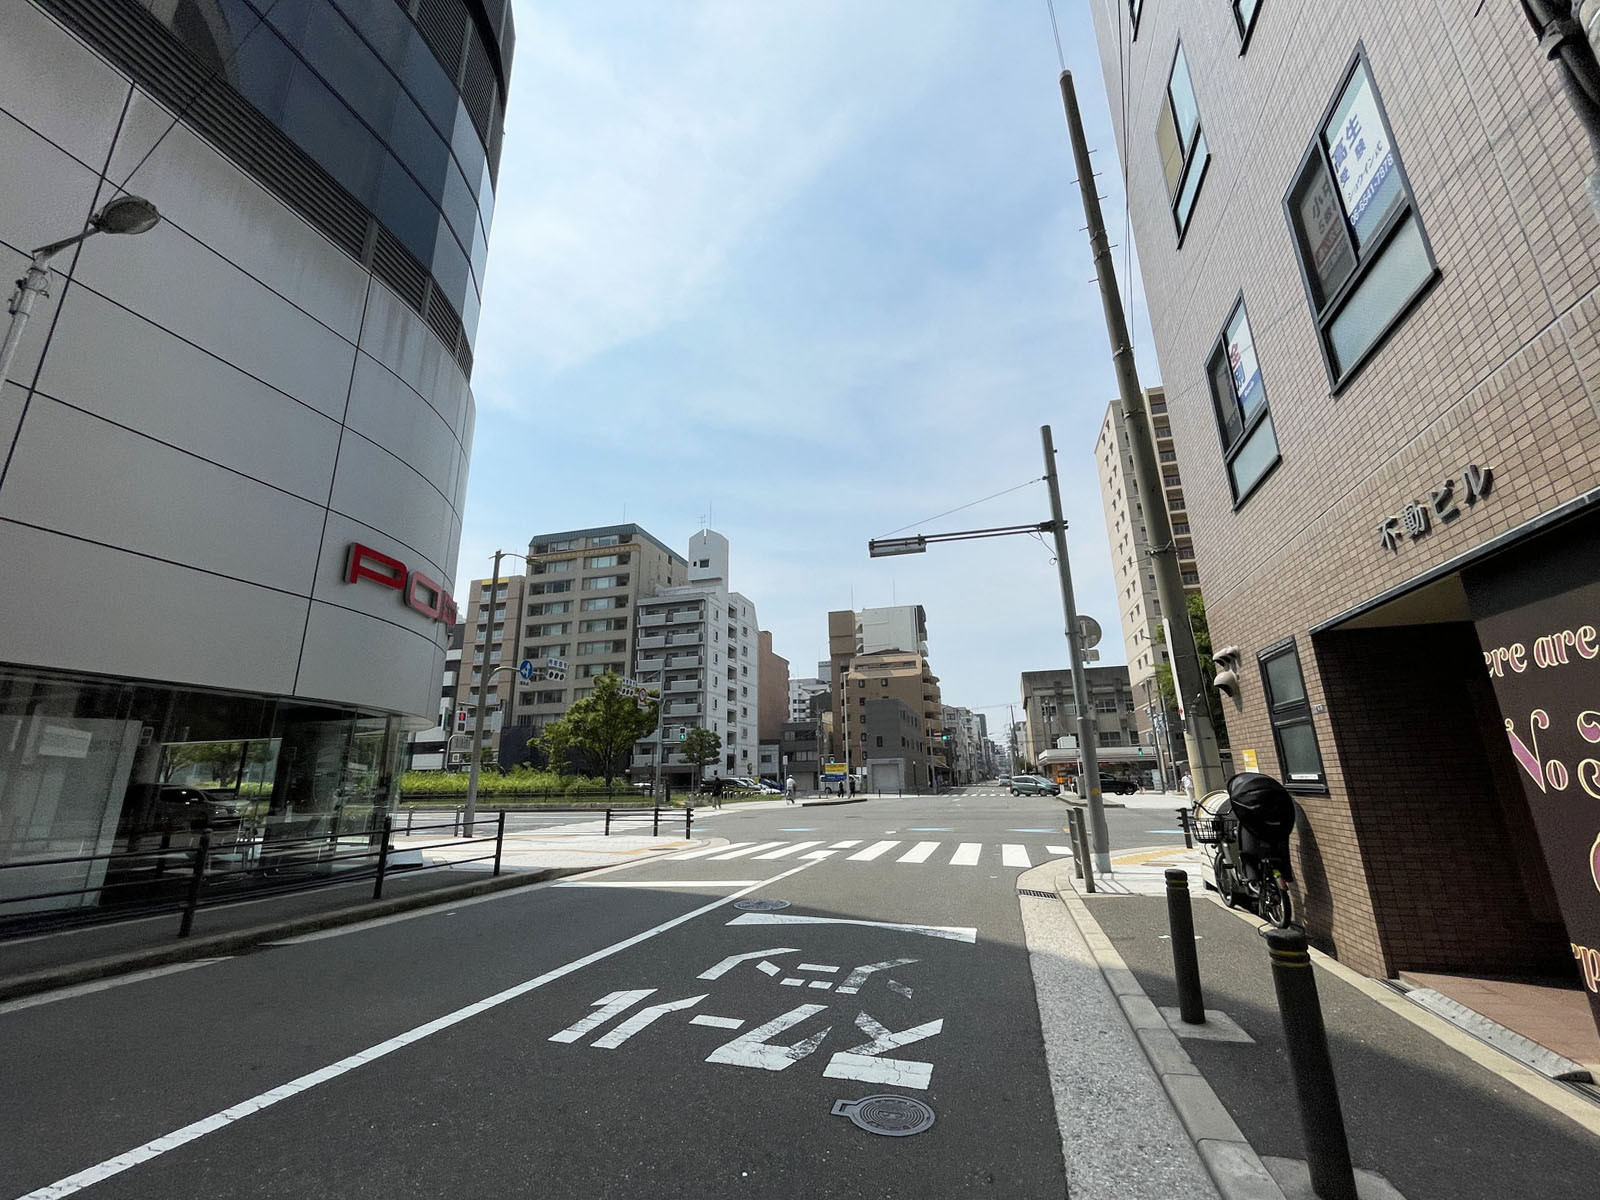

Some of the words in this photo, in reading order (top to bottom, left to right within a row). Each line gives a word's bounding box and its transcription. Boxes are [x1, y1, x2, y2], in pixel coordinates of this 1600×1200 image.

[1375, 464, 1494, 555] 不動ビル
[1533, 625, 1599, 669] are
